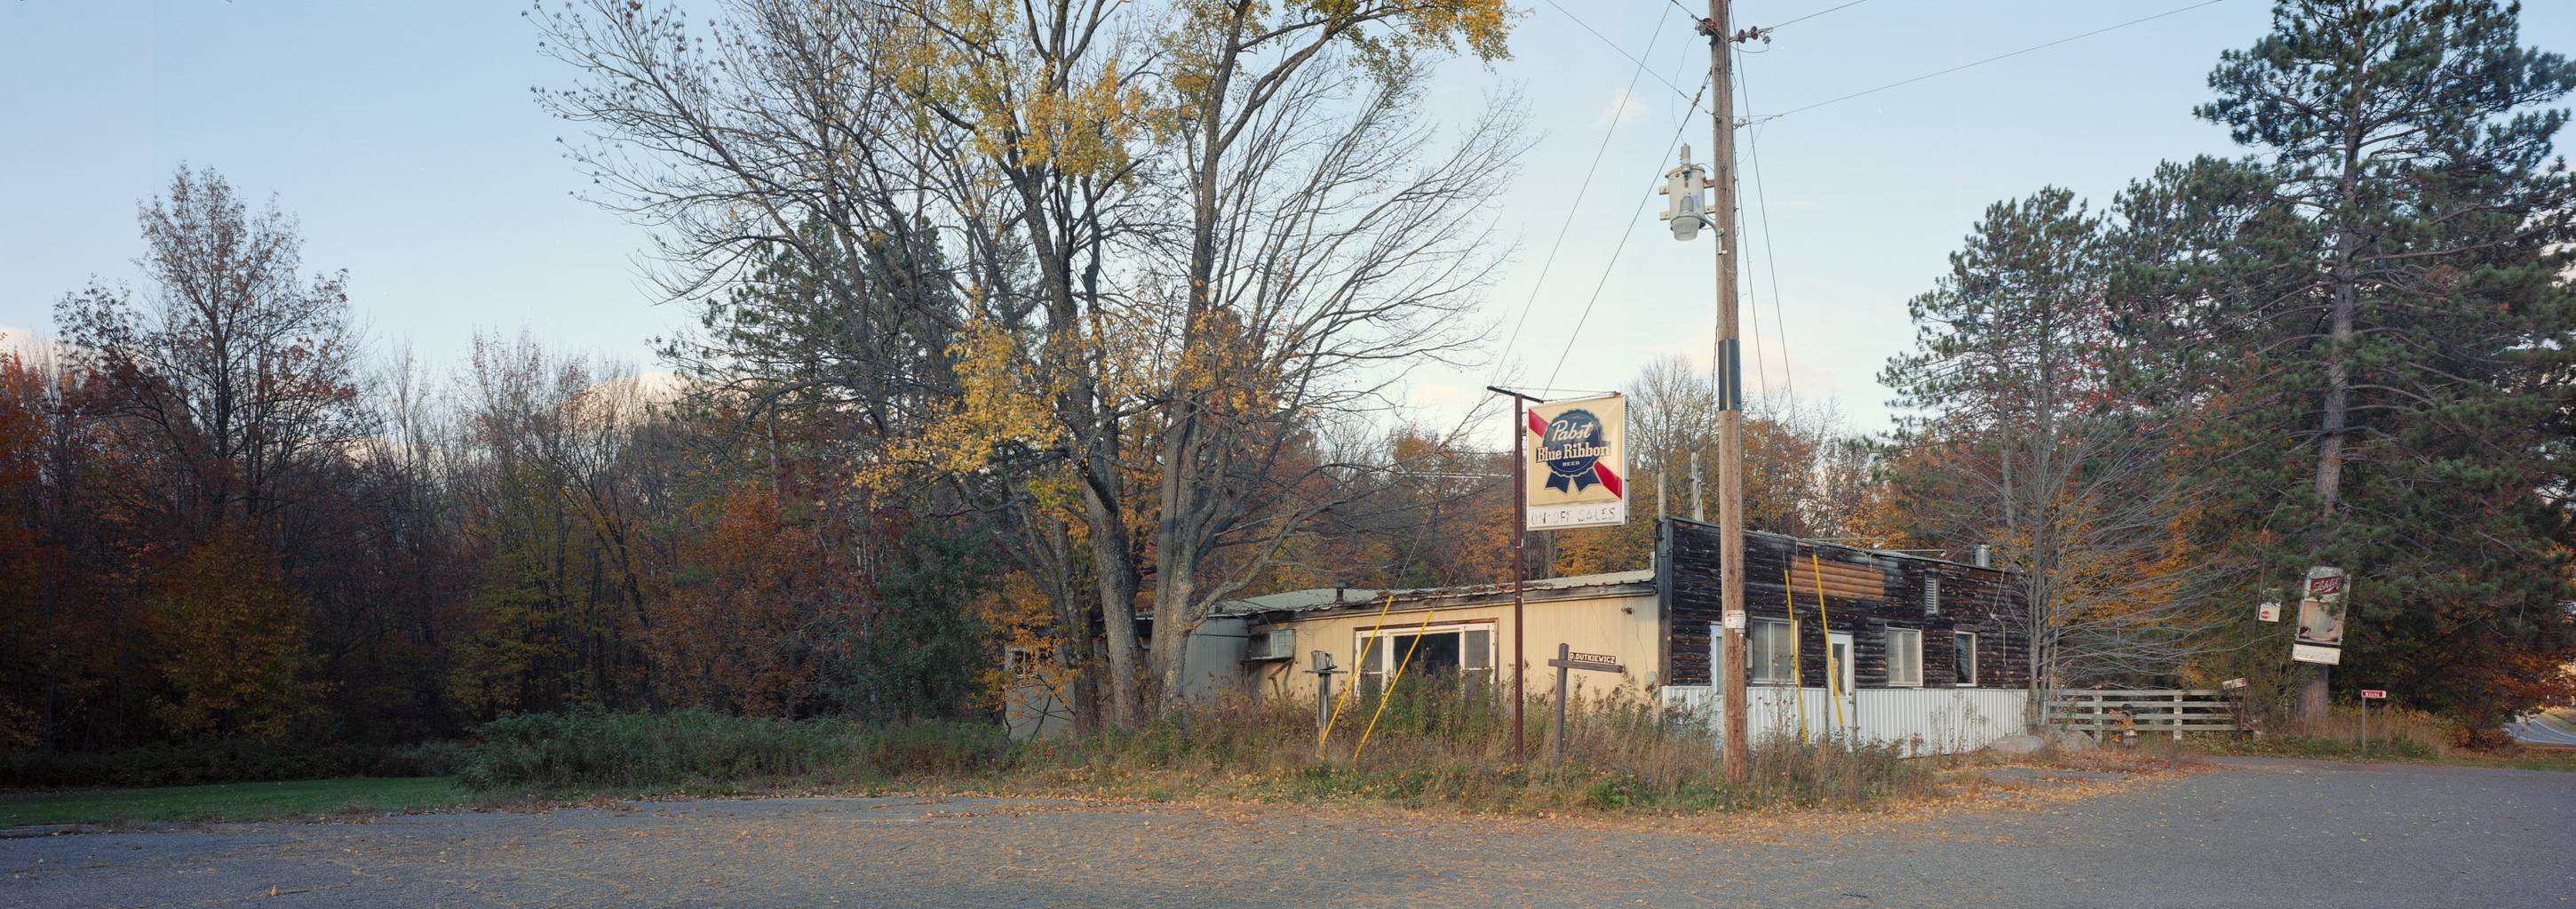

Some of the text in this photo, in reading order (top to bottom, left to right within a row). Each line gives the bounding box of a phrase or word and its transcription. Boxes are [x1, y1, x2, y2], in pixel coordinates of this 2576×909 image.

[1552, 419, 1594, 442] Pabst
[1537, 442, 1610, 462] Blue Ribbon
